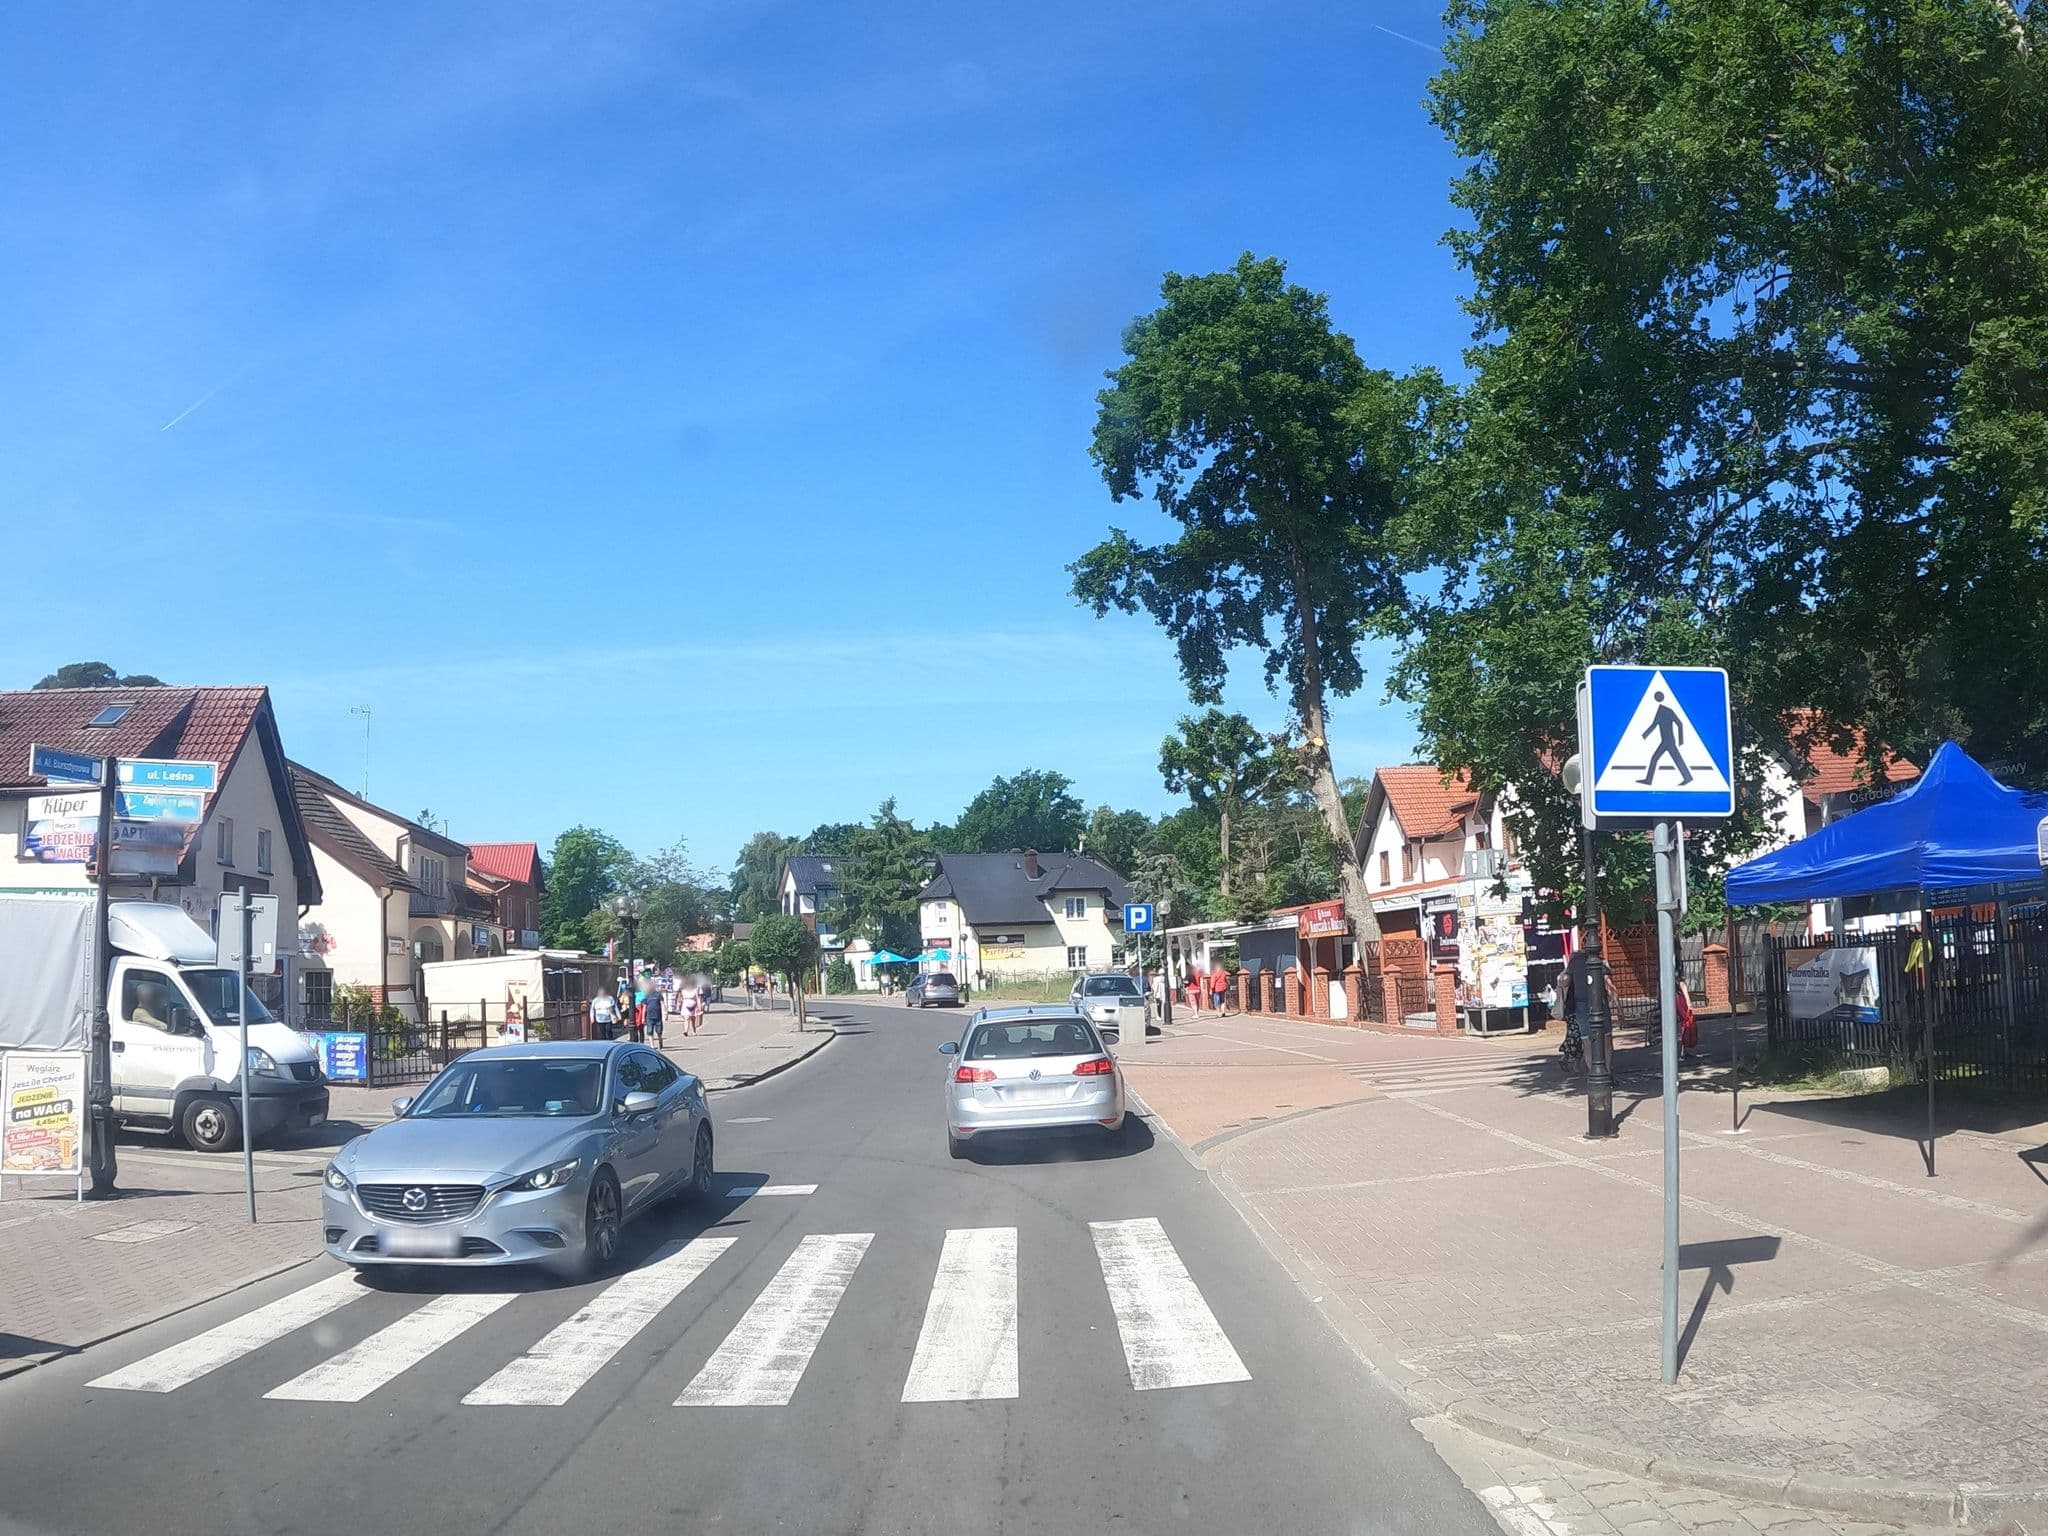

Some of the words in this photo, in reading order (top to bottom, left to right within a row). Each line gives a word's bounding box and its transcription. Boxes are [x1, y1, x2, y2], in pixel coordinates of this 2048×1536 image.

[147, 770, 160, 780] ul.
[162, 770, 194, 781] Leśna
[1849, 786, 1897, 804] Ośrodek
[42, 798, 88, 817] Kliper
[40, 833, 93, 846] JEDZENIE
[1130, 907, 1147, 930] P
[17, 1091, 54, 1104] JEDZENIE
[15, 1109, 32, 1120] na
